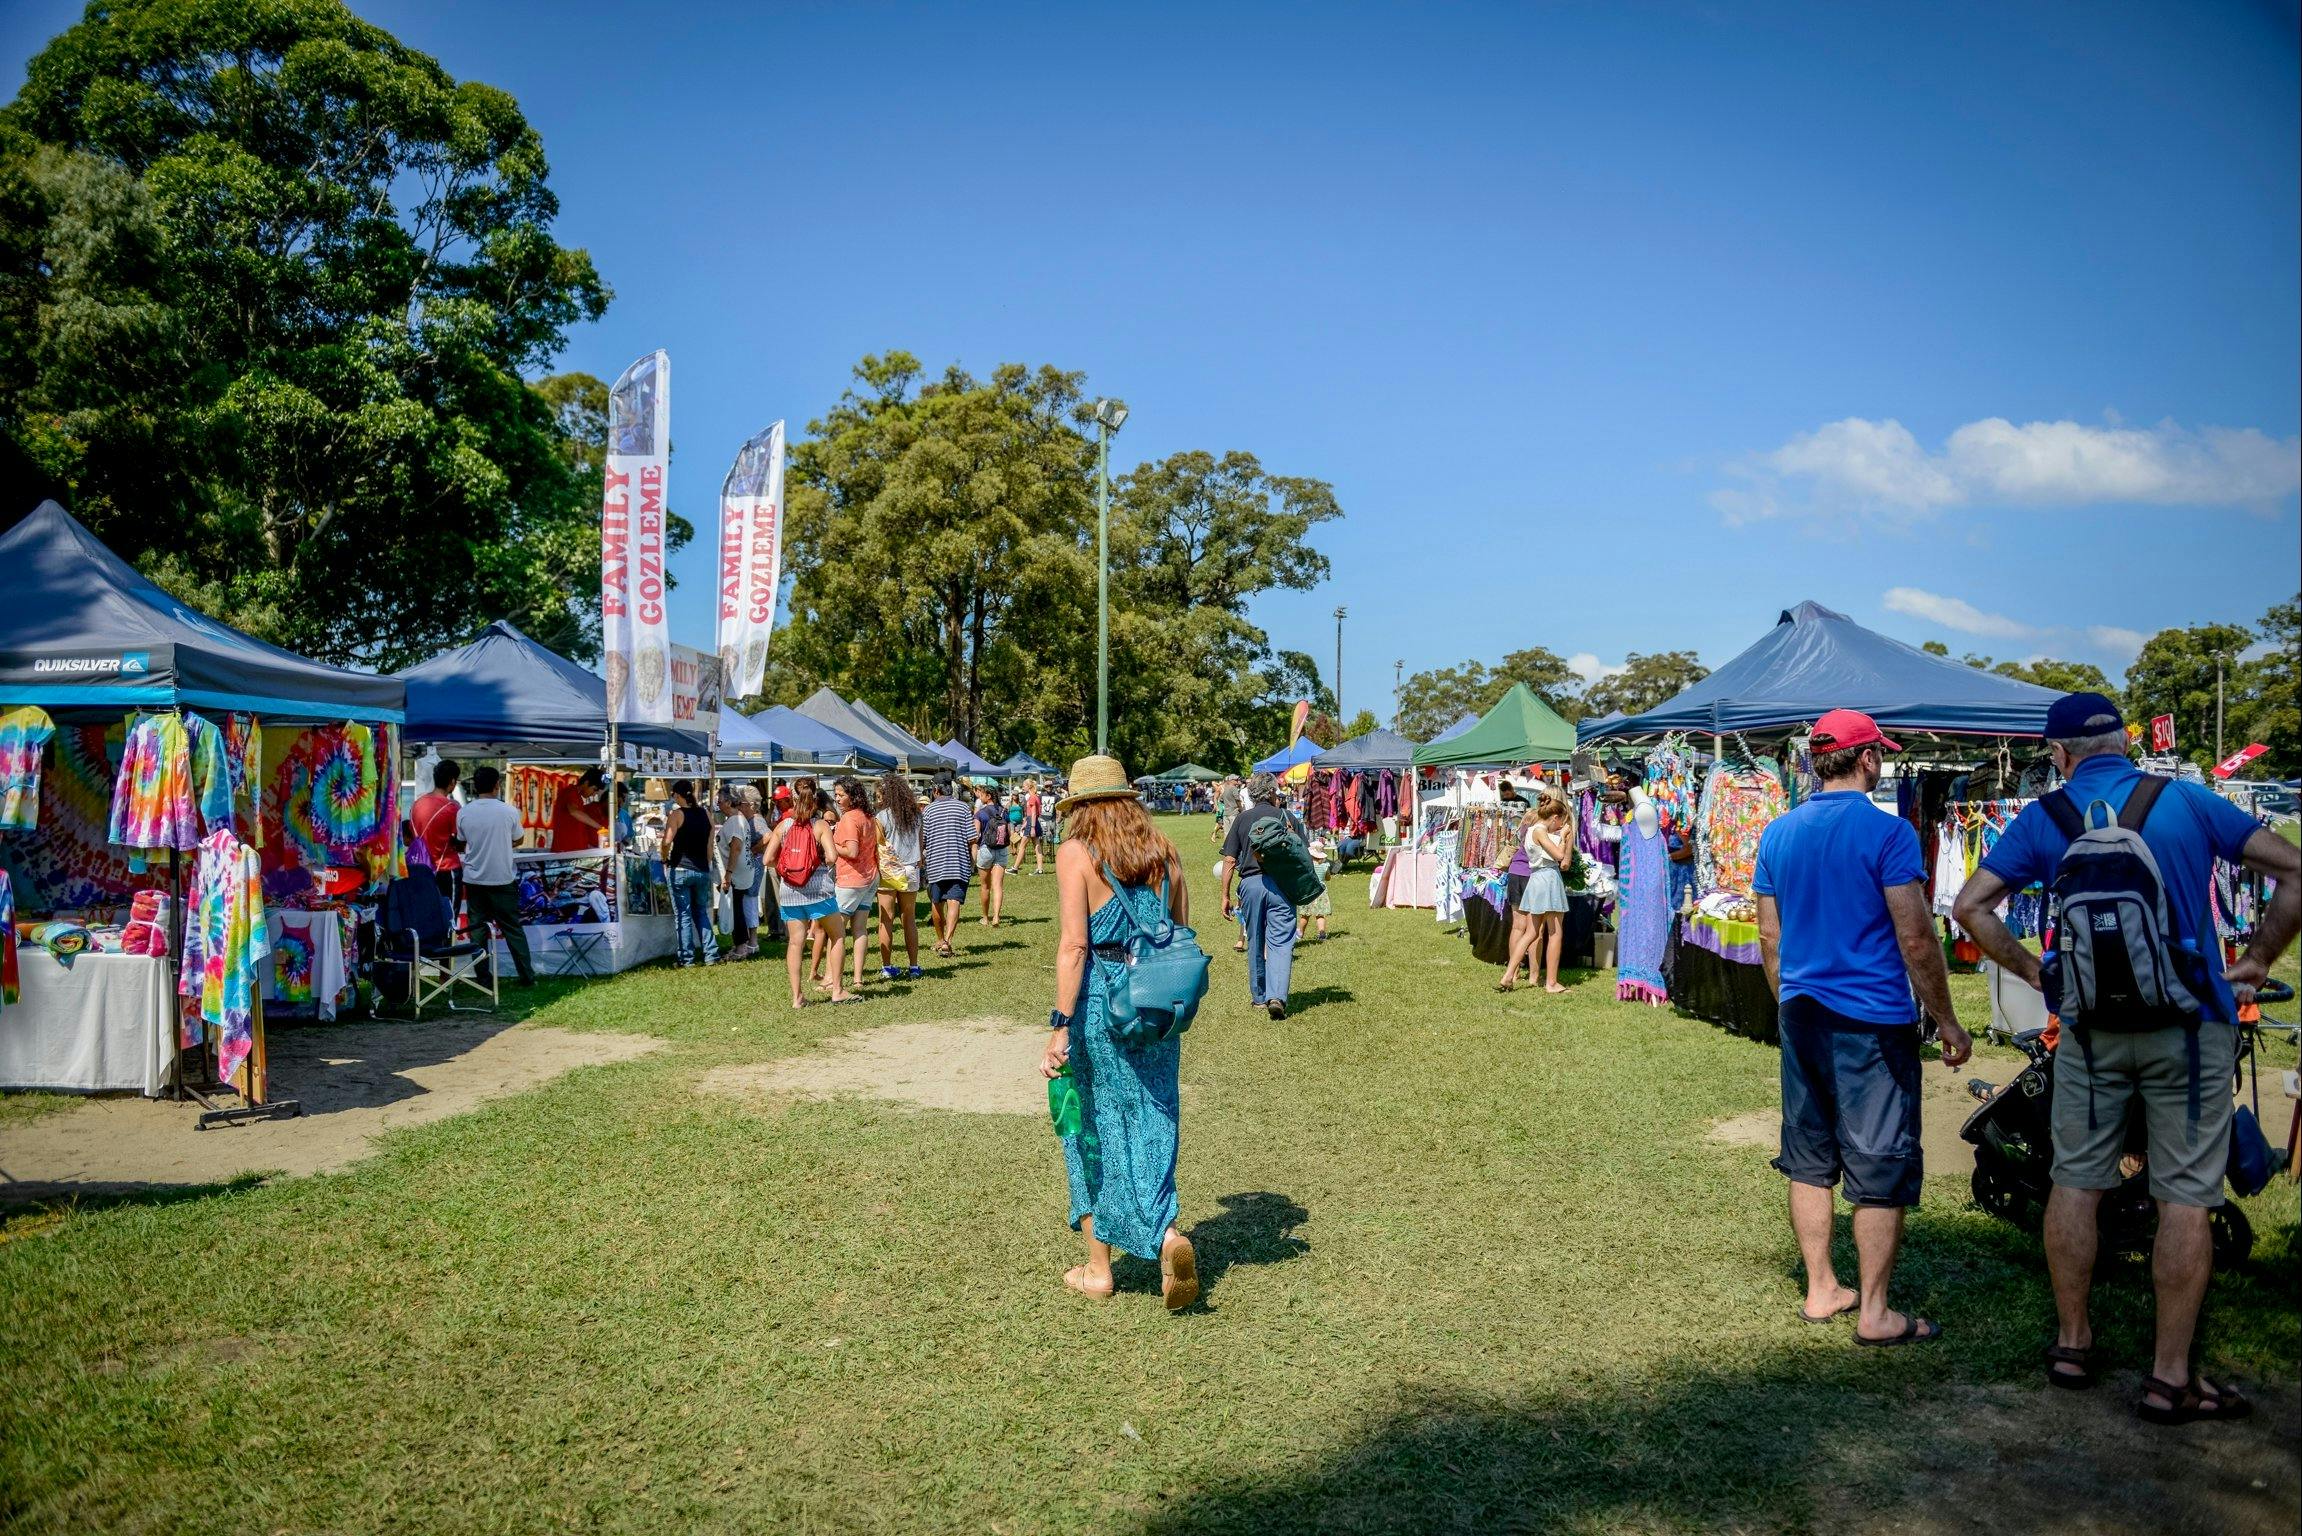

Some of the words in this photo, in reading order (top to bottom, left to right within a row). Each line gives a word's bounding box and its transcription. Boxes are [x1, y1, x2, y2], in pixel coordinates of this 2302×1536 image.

[603, 464, 630, 618] FAMILY
[639, 465, 662, 625] GOZLEME
[723, 504, 743, 620] FAMILY
[749, 504, 776, 624] GOZLEME
[34, 659, 120, 672] QUIKSILVER
[2155, 720, 2171, 746] $10
